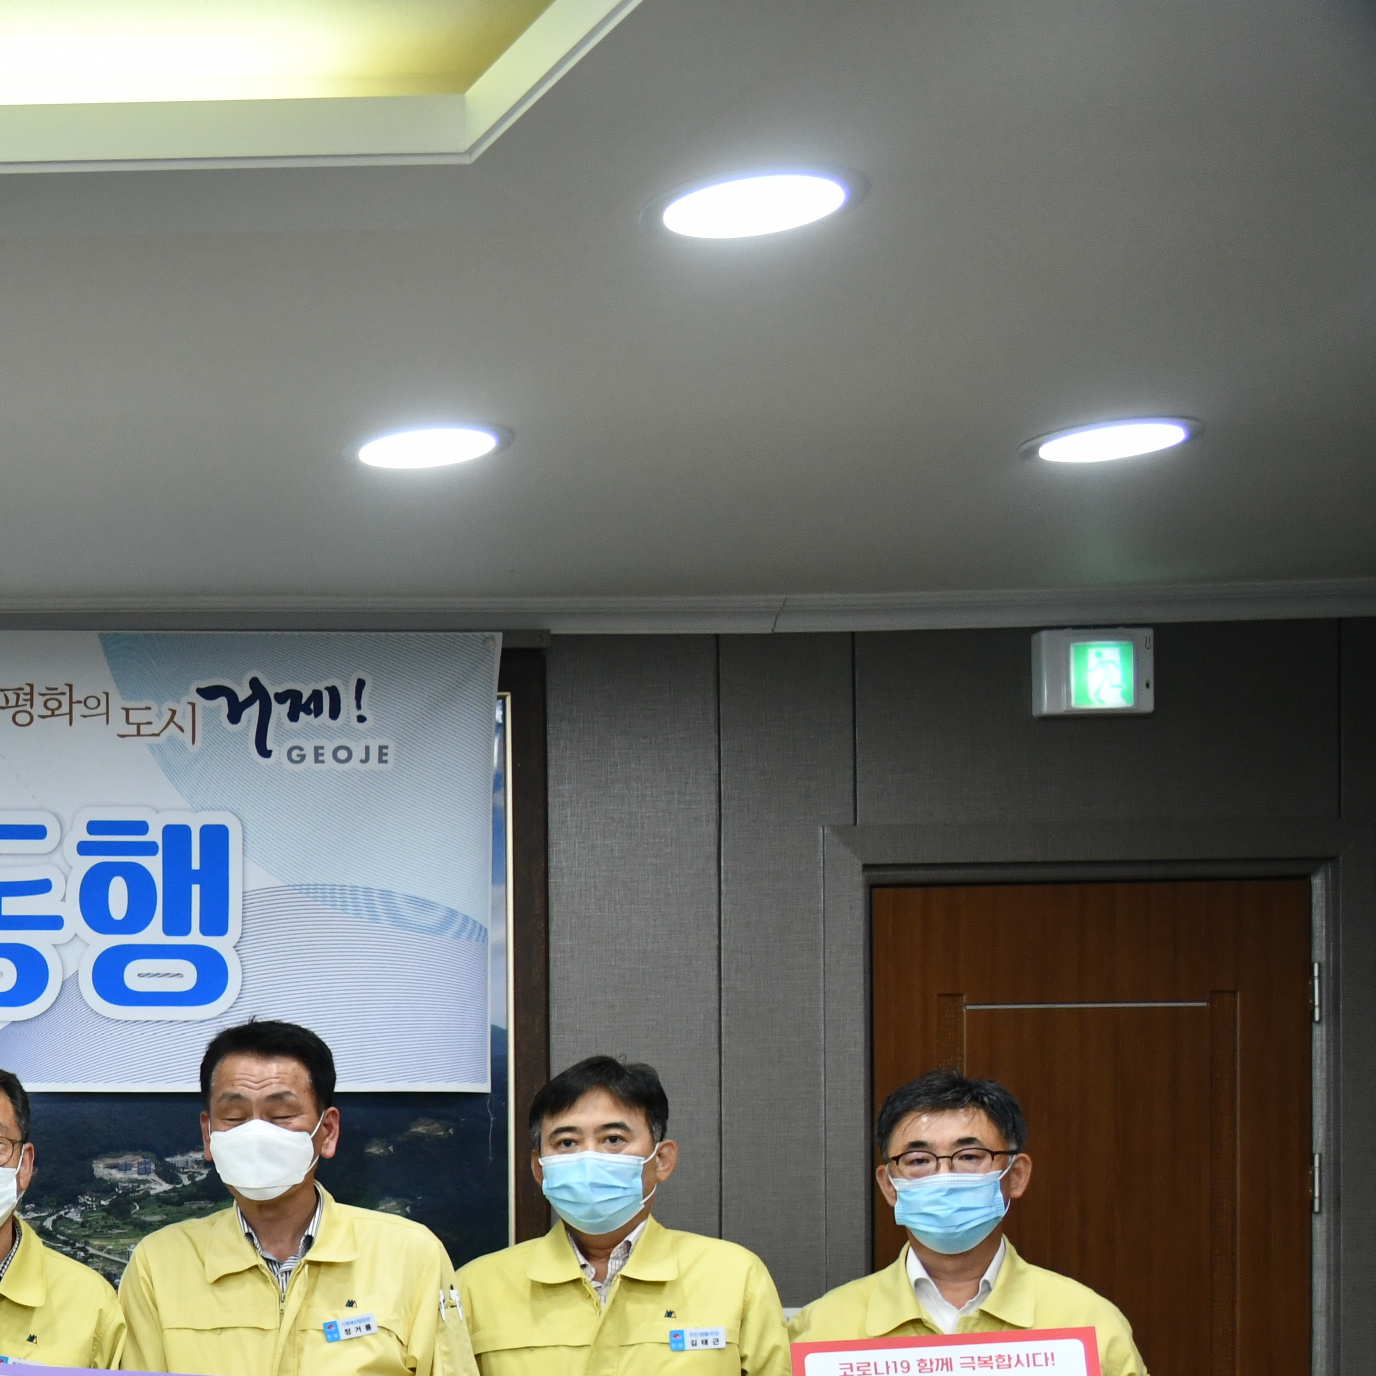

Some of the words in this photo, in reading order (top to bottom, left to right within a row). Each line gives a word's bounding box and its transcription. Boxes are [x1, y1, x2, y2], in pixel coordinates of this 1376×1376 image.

[116, 701, 197, 746] 도시
[286, 744, 389, 765] GEOJE
[916, 1357, 954, 1374] 함께
[959, 1351, 1055, 1371] 극복합시다!
